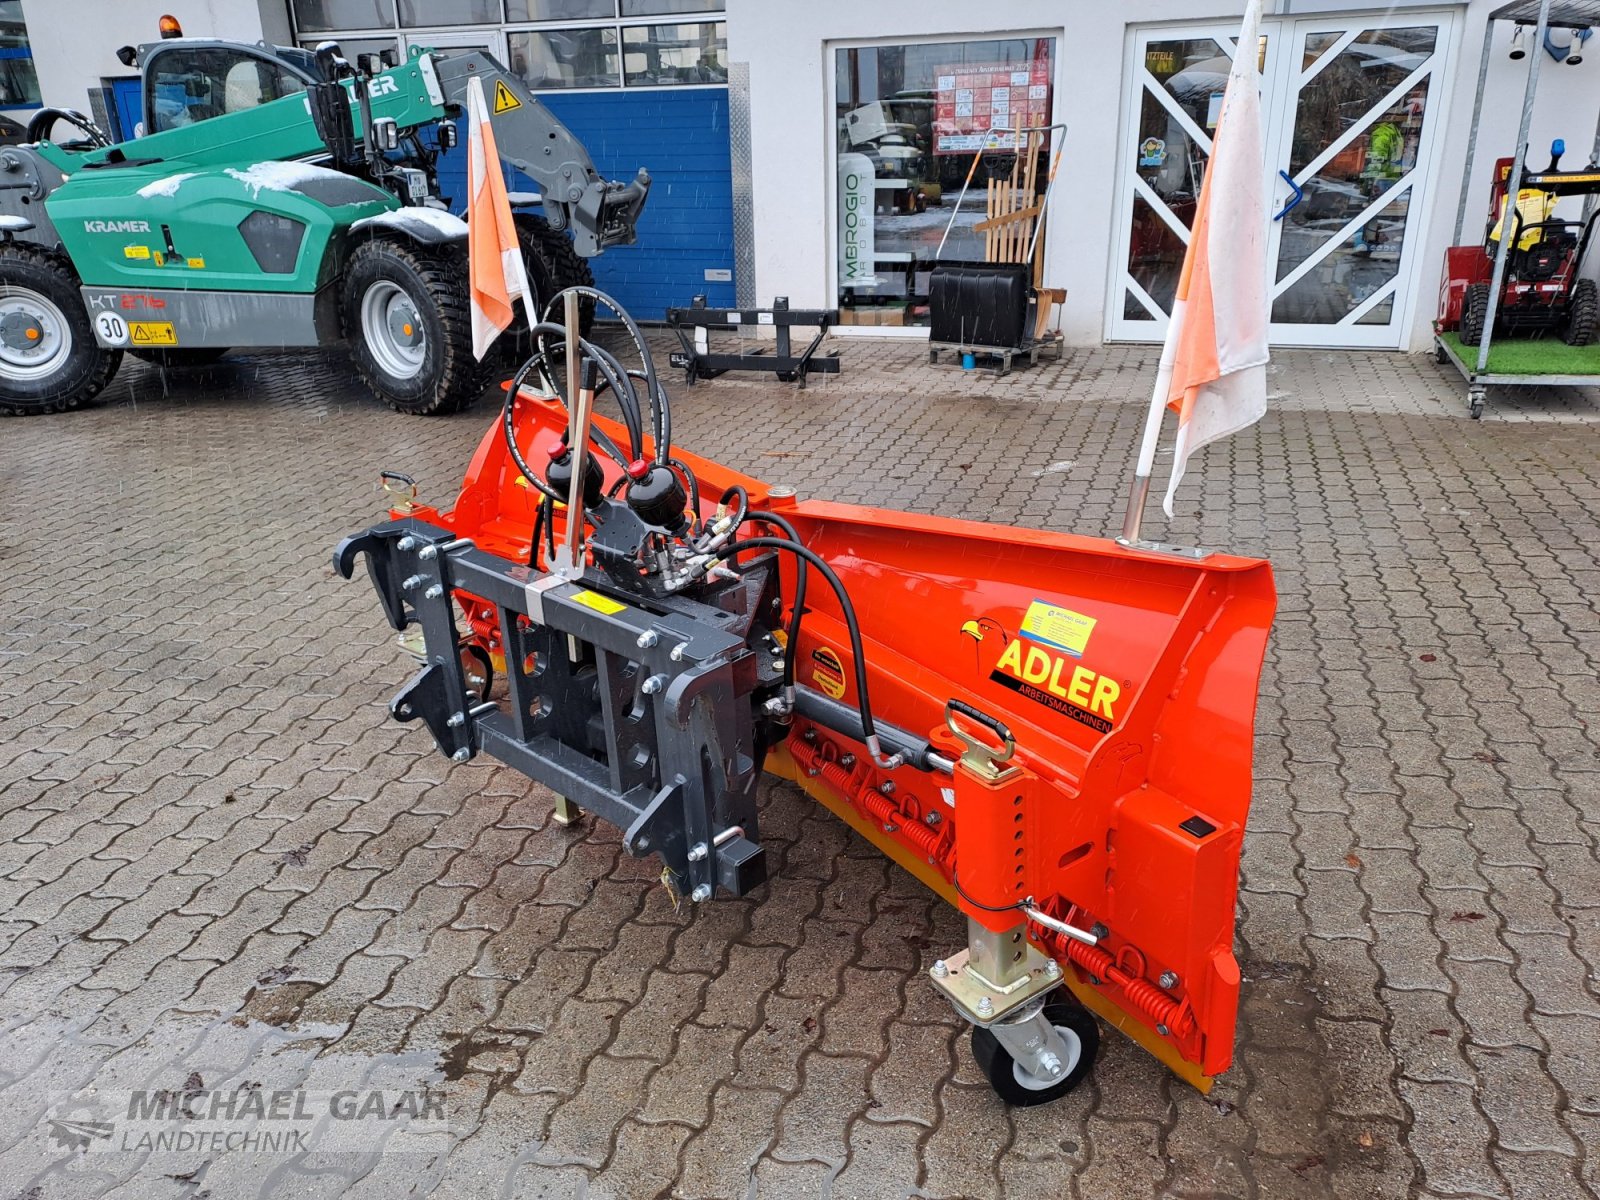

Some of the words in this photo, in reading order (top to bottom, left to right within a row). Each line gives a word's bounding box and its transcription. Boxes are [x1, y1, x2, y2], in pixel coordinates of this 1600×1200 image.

[84, 221, 151, 232] KRAMER
[89, 295, 116, 309] KT
[121, 294, 166, 309] 276
[101, 318, 123, 338] 30
[996, 638, 1121, 720] ADLER
[1018, 684, 1112, 733] ARBEITSMASCHINEN
